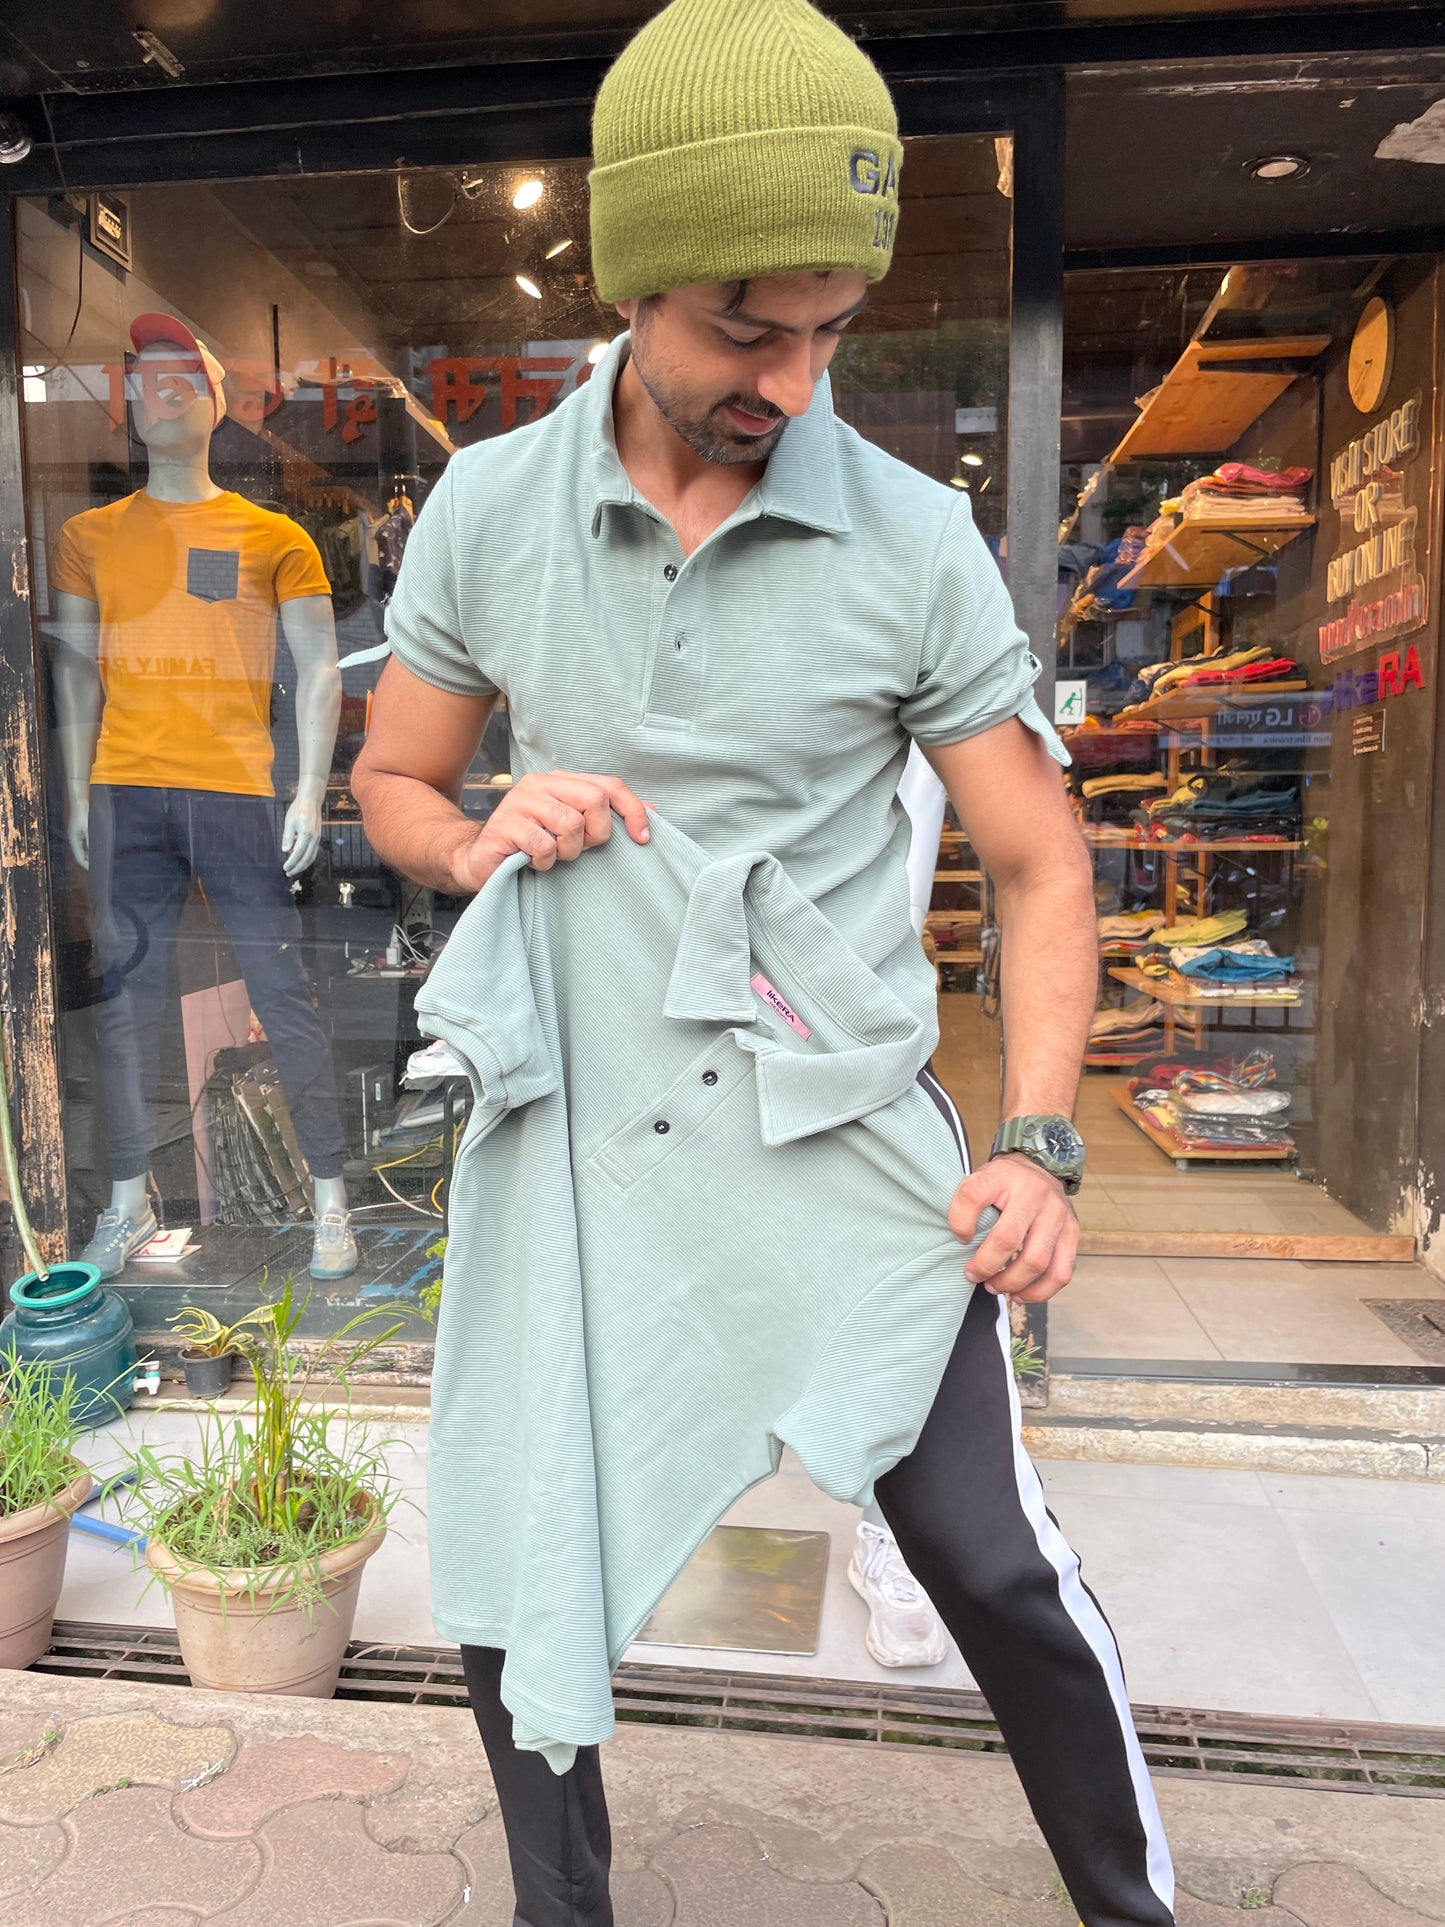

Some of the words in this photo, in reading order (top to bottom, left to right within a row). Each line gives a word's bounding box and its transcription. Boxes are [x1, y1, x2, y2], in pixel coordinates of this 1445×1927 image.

[1330, 440, 1362, 499] VISIT
[1363, 399, 1415, 476] STORE
[1354, 482, 1380, 533] OR
[1327, 550, 1356, 603] BUY
[1354, 518, 1411, 587] ONLINE
